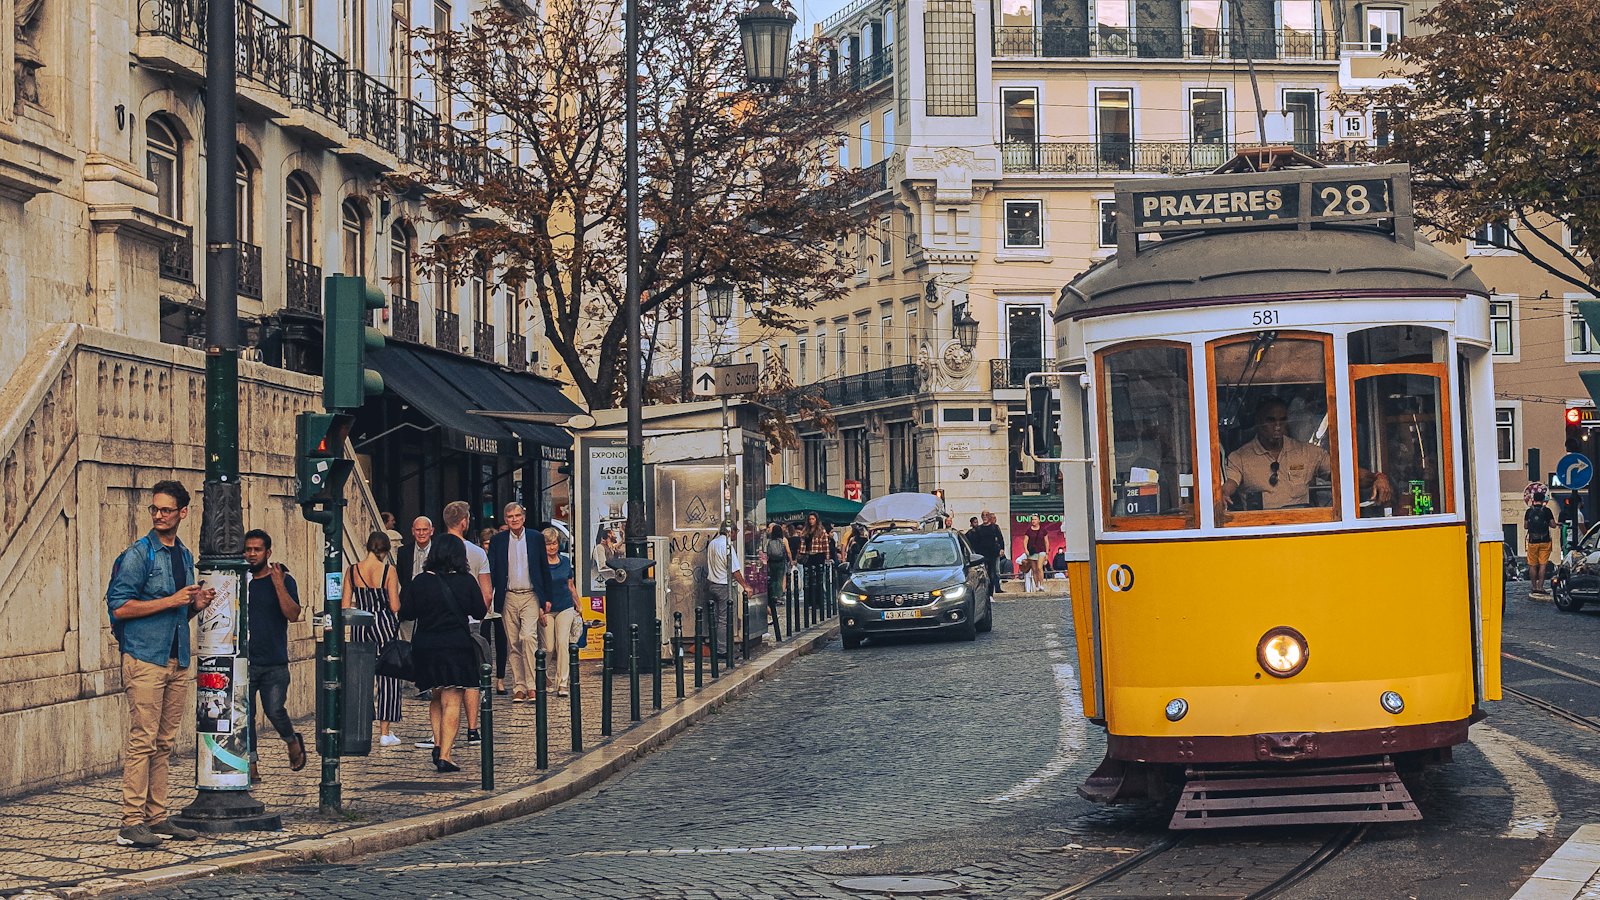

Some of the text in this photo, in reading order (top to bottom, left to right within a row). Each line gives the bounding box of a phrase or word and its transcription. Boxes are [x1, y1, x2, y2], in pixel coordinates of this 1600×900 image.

[1345, 117, 1360, 131] 15
[1142, 189, 1283, 217] PRAZERES
[1320, 184, 1371, 217] 28
[1252, 309, 1279, 326] 581
[724, 370, 756, 387] C. Sodré
[480, 438, 498, 454] ALEGRE
[591, 451, 627, 459] EXPONOI
[600, 466, 628, 475] LISBO
[1126, 488, 1139, 497] 28E
[1127, 502, 1139, 513] 01
